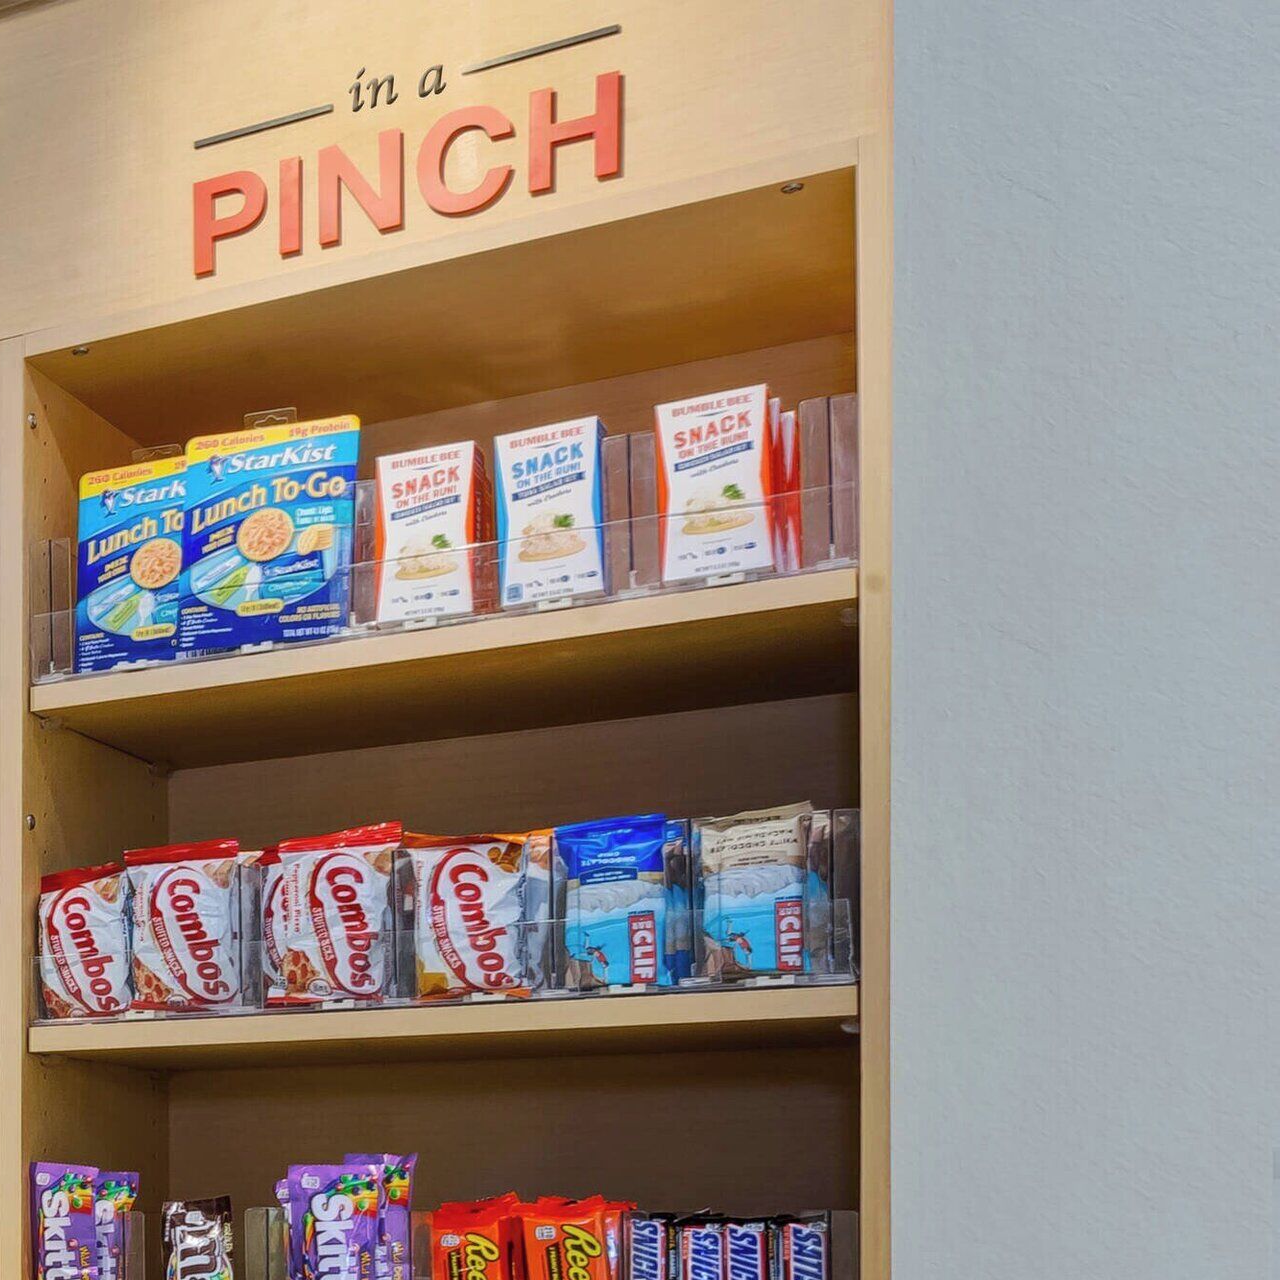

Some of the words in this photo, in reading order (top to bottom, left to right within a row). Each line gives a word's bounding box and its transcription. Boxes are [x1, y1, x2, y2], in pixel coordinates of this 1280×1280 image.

[347, 66, 401, 113] in
[416, 62, 449, 99] a
[192, 69, 624, 279] PINCH
[671, 397, 726, 418] BUMBLE
[673, 409, 753, 449] SNACK
[228, 443, 338, 474] StarKist
[391, 453, 435, 470] BUMBLE
[438, 449, 462, 462] BEE
[391, 465, 462, 500] SNACK
[511, 441, 585, 480] SNACK
[533, 470, 553, 485] THE
[120, 480, 187, 507] StarK
[191, 483, 268, 536] Lunch
[412, 491, 431, 505] THE
[86, 514, 159, 566] Lunch
[167, 878, 230, 996] Combos
[325, 866, 380, 988] Combos
[449, 863, 514, 987] Combos
[780, 915, 803, 967] CLIF
[61, 896, 120, 1011] Combos
[633, 929, 657, 980] CLIF
